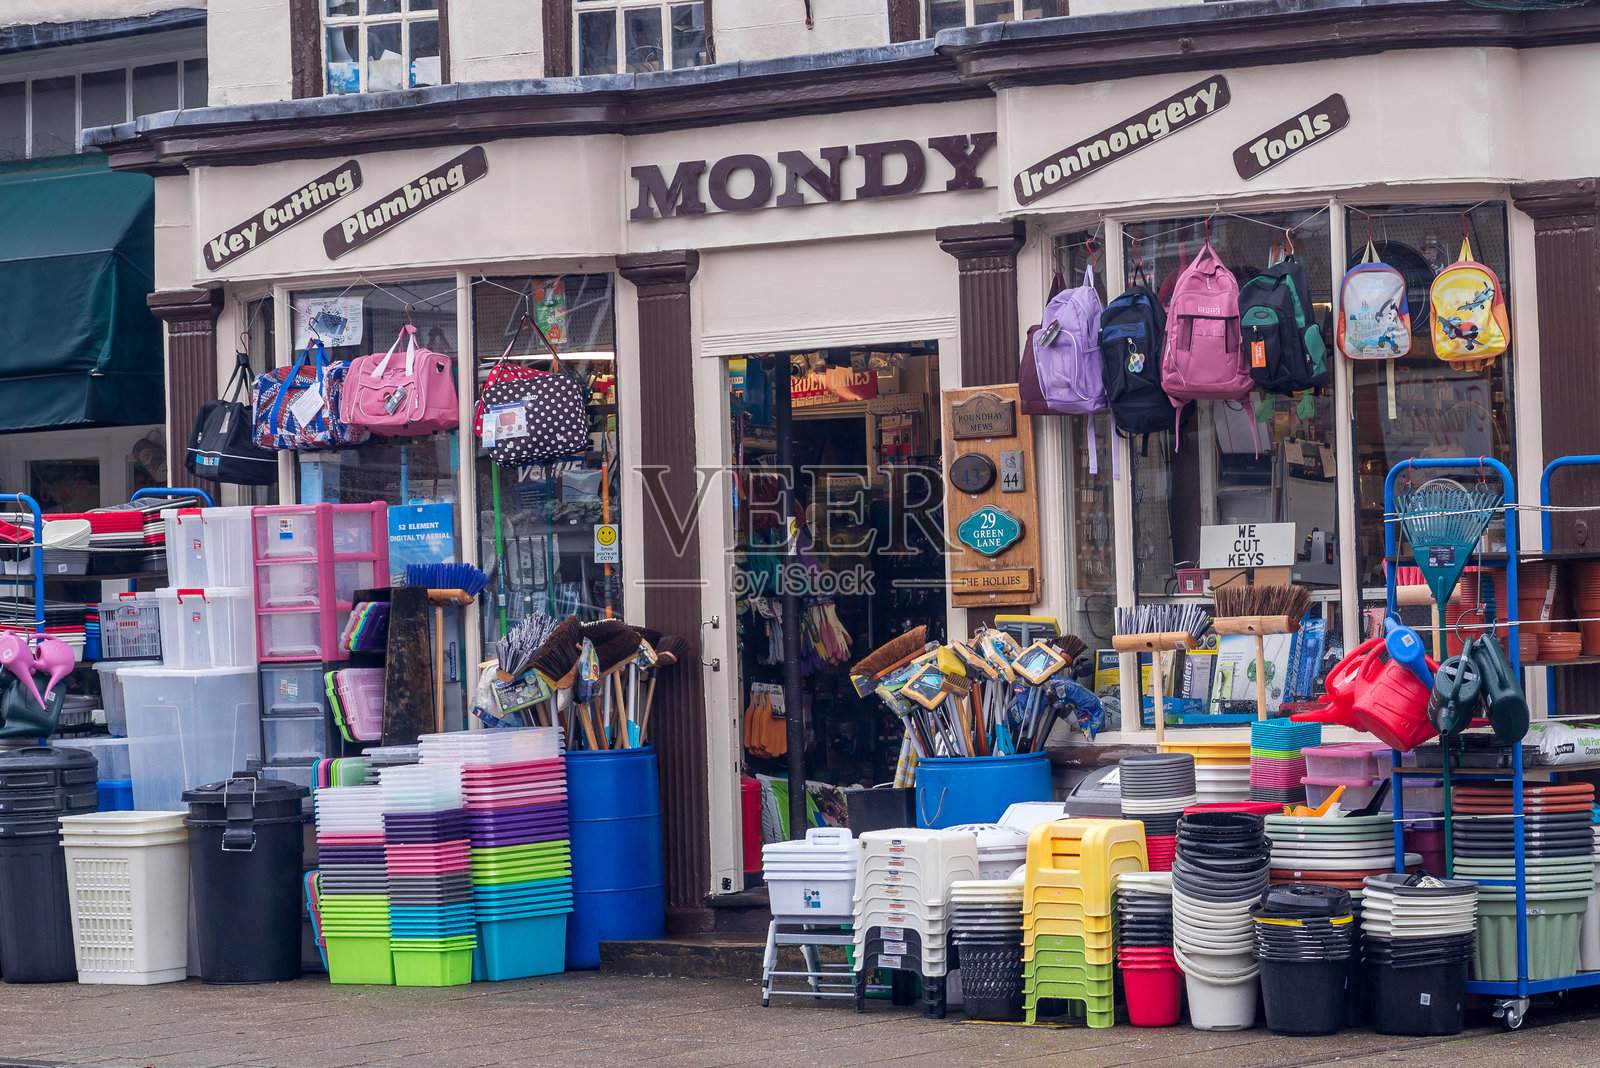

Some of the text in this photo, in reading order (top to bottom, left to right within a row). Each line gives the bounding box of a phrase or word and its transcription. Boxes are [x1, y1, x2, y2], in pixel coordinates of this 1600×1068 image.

[1017, 82, 1218, 199] Ironmongery
[1248, 110, 1331, 168] Tools
[629, 132, 997, 220] MONDY
[342, 163, 465, 245] Plumbing
[209, 170, 354, 262] Key Cutting
[791, 371, 870, 393] ARDEN CANES
[958, 412, 1003, 423] ROUNDHAY
[970, 423, 993, 432] MEWS
[961, 469, 981, 488] 43
[1003, 472, 1019, 488] 44
[409, 521, 439, 530] ELEMENT
[980, 512, 996, 529] 29
[390, 532, 451, 542] DIGITAL TV AERIAL
[973, 528, 1004, 539] GREEN
[1238, 525, 1256, 538] WE
[977, 538, 1002, 548] LANE
[1234, 539, 1261, 552] CUT
[1229, 553, 1265, 567] KEYS
[960, 575, 1021, 587] THE HOLLIES
[1182, 661, 1192, 698] efenders
[1591, 737, 1600, 746] Pur
